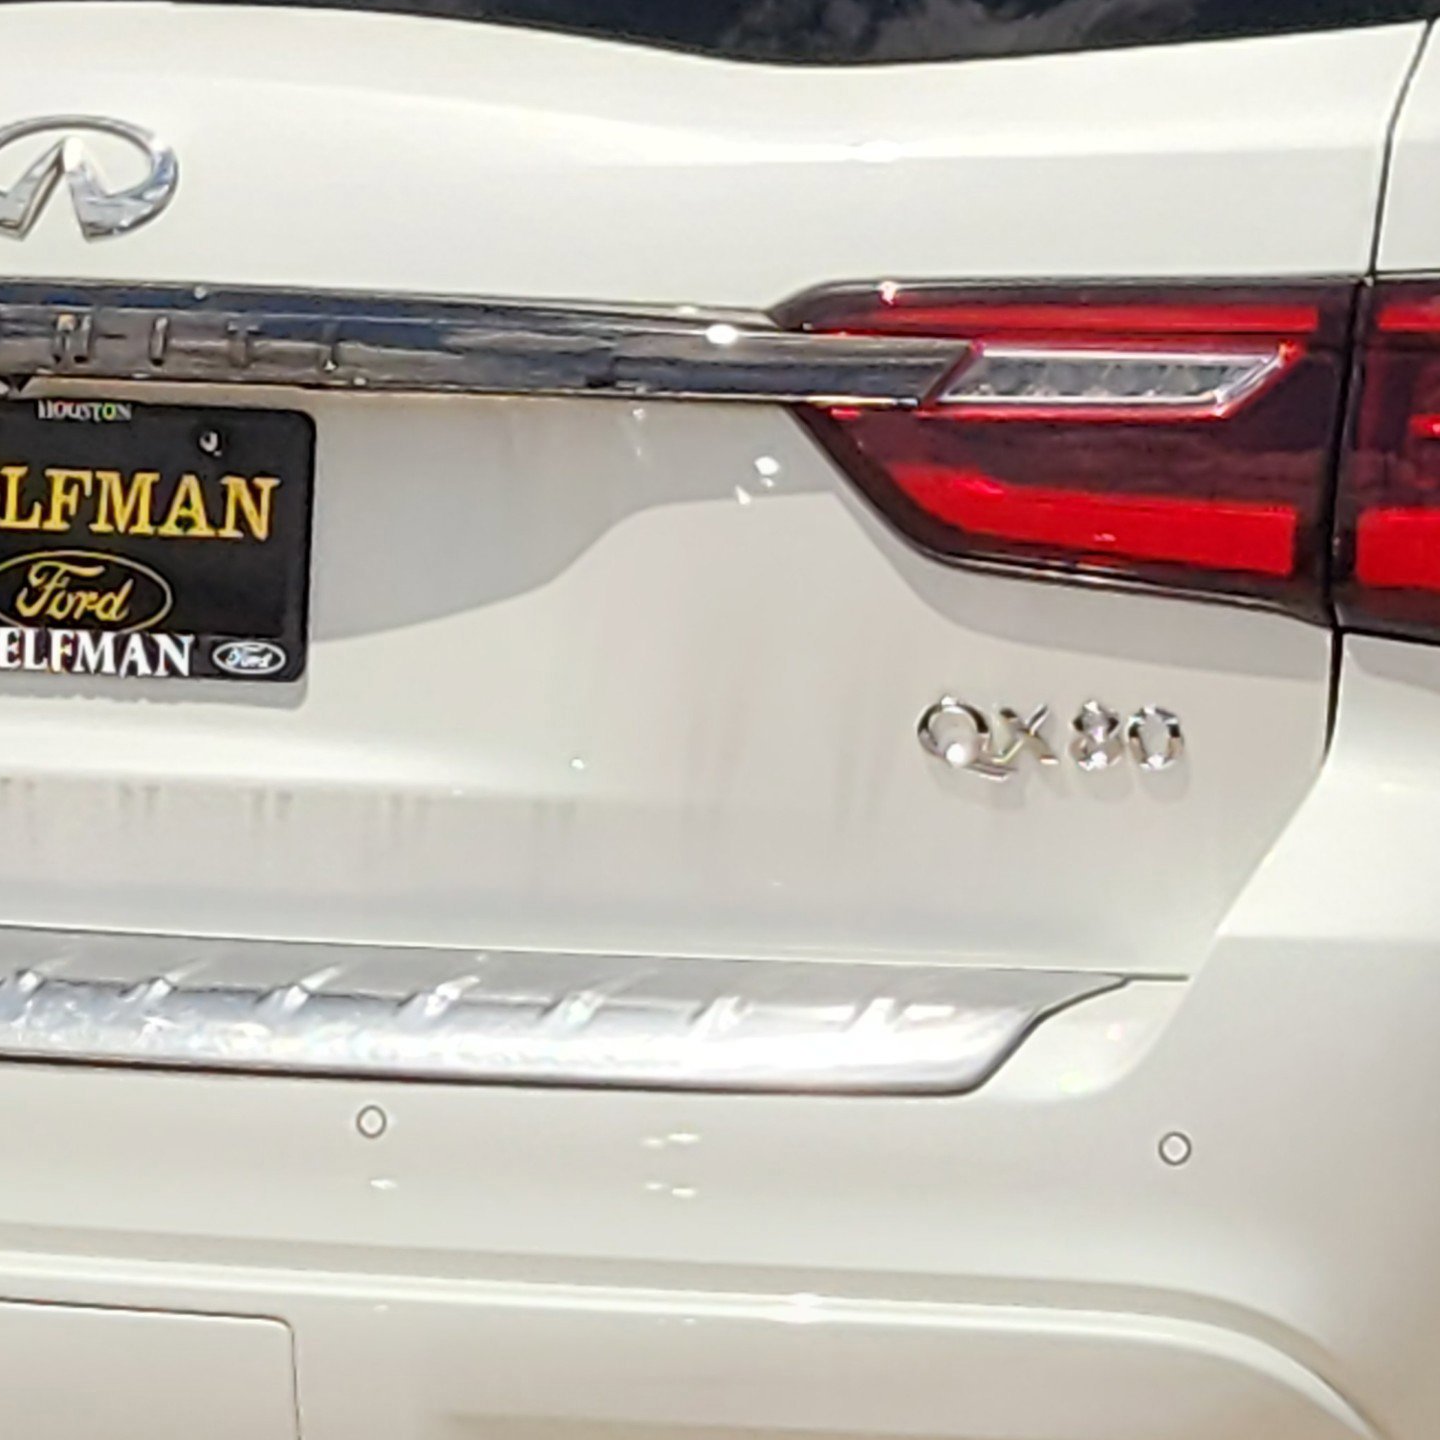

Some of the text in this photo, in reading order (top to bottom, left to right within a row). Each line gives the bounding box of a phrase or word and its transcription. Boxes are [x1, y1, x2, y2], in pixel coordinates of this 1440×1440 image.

[37, 400, 133, 422] HOUSTON
[15, 561, 135, 623] Ford
[916, 695, 1186, 782] QX80
